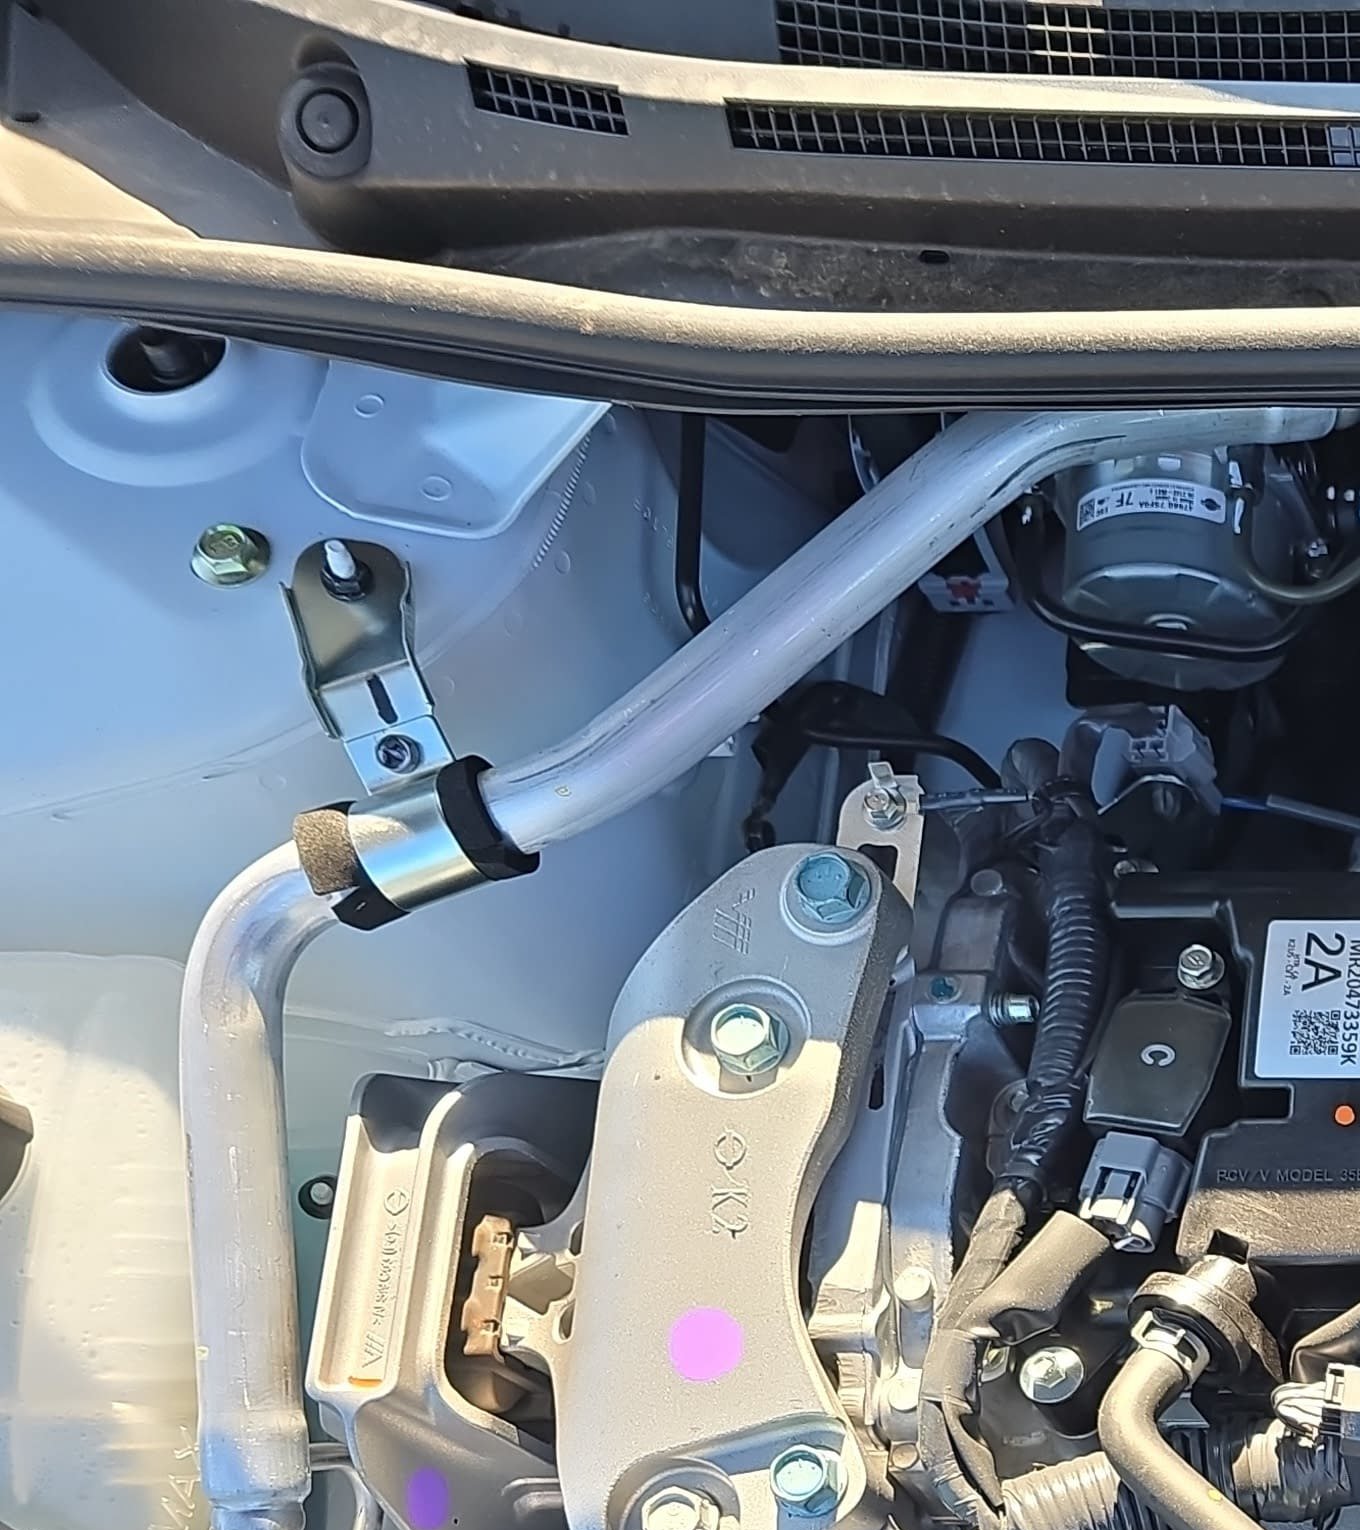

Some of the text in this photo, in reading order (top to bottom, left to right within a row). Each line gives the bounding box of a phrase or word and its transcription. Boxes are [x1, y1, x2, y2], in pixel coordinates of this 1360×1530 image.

[1115, 492, 1133, 507] 7F
[1301, 931, 1347, 992] 2A
[1276, 1168, 1334, 1183] MODEL
